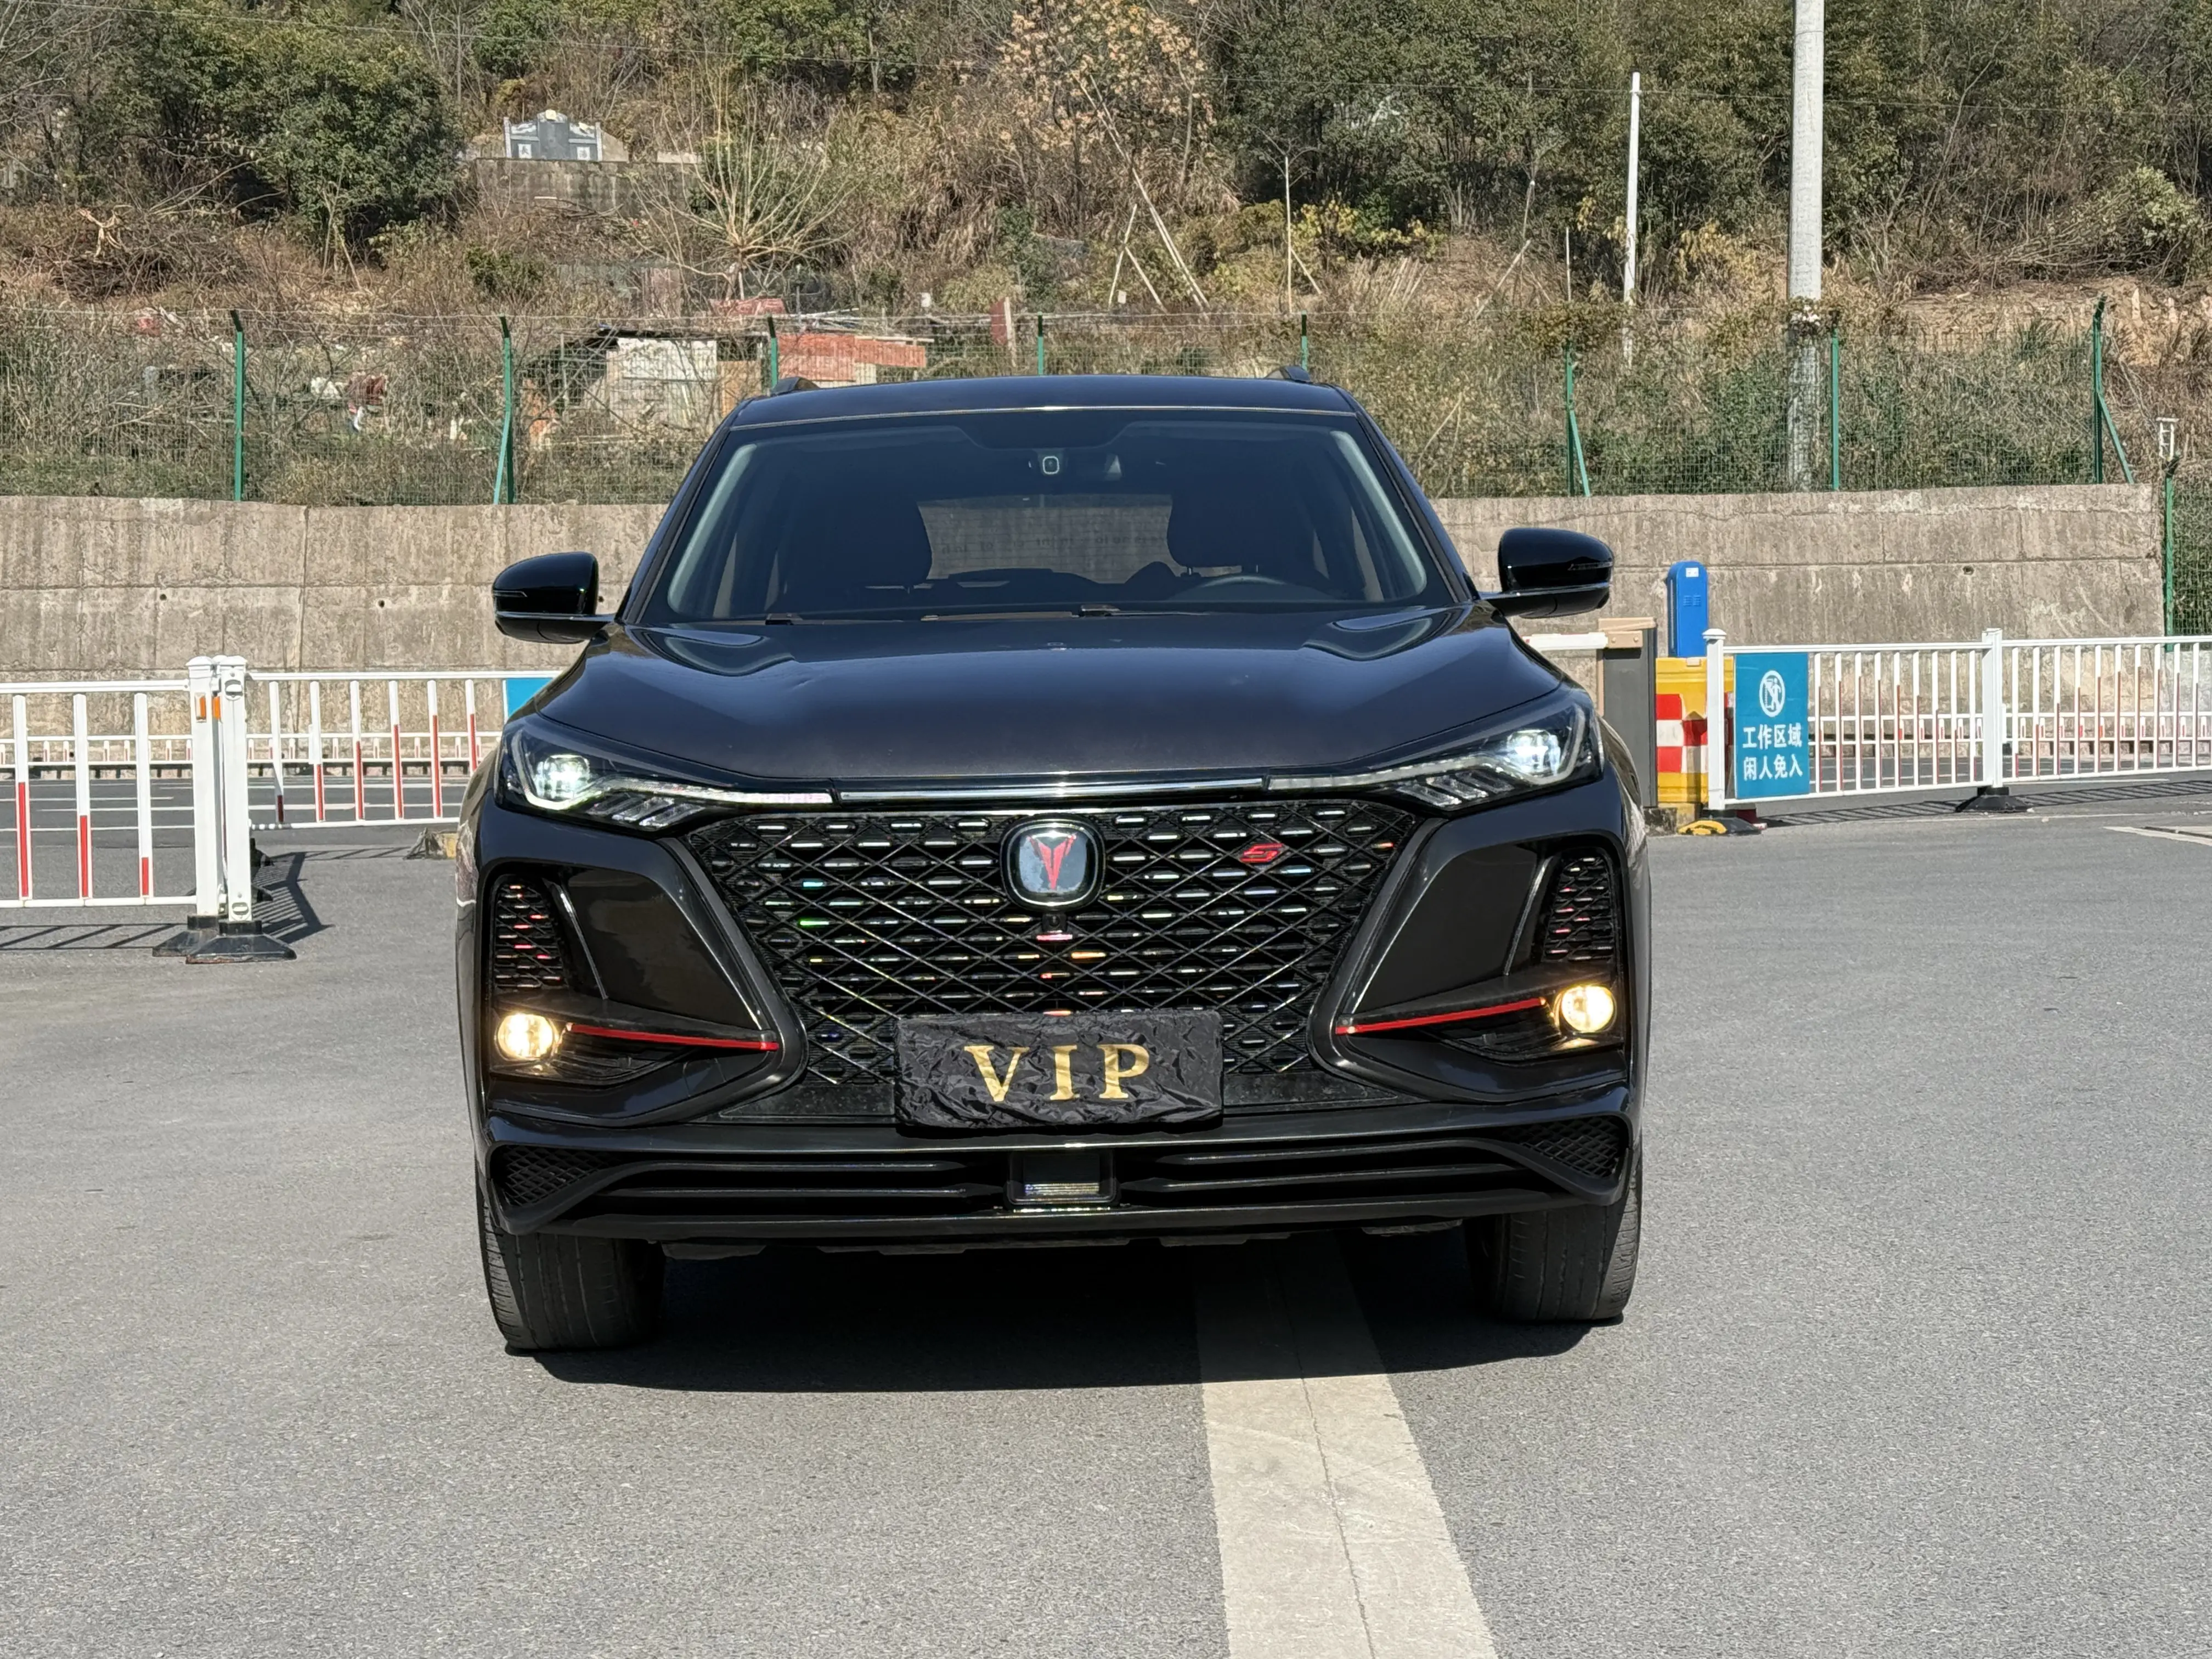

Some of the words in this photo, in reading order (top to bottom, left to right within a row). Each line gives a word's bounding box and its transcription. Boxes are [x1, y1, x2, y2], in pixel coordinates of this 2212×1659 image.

[1742, 723, 1802, 749] 工作区域
[1743, 754, 1803, 781] 闲人免入
[964, 1043, 1150, 1102] VIP
